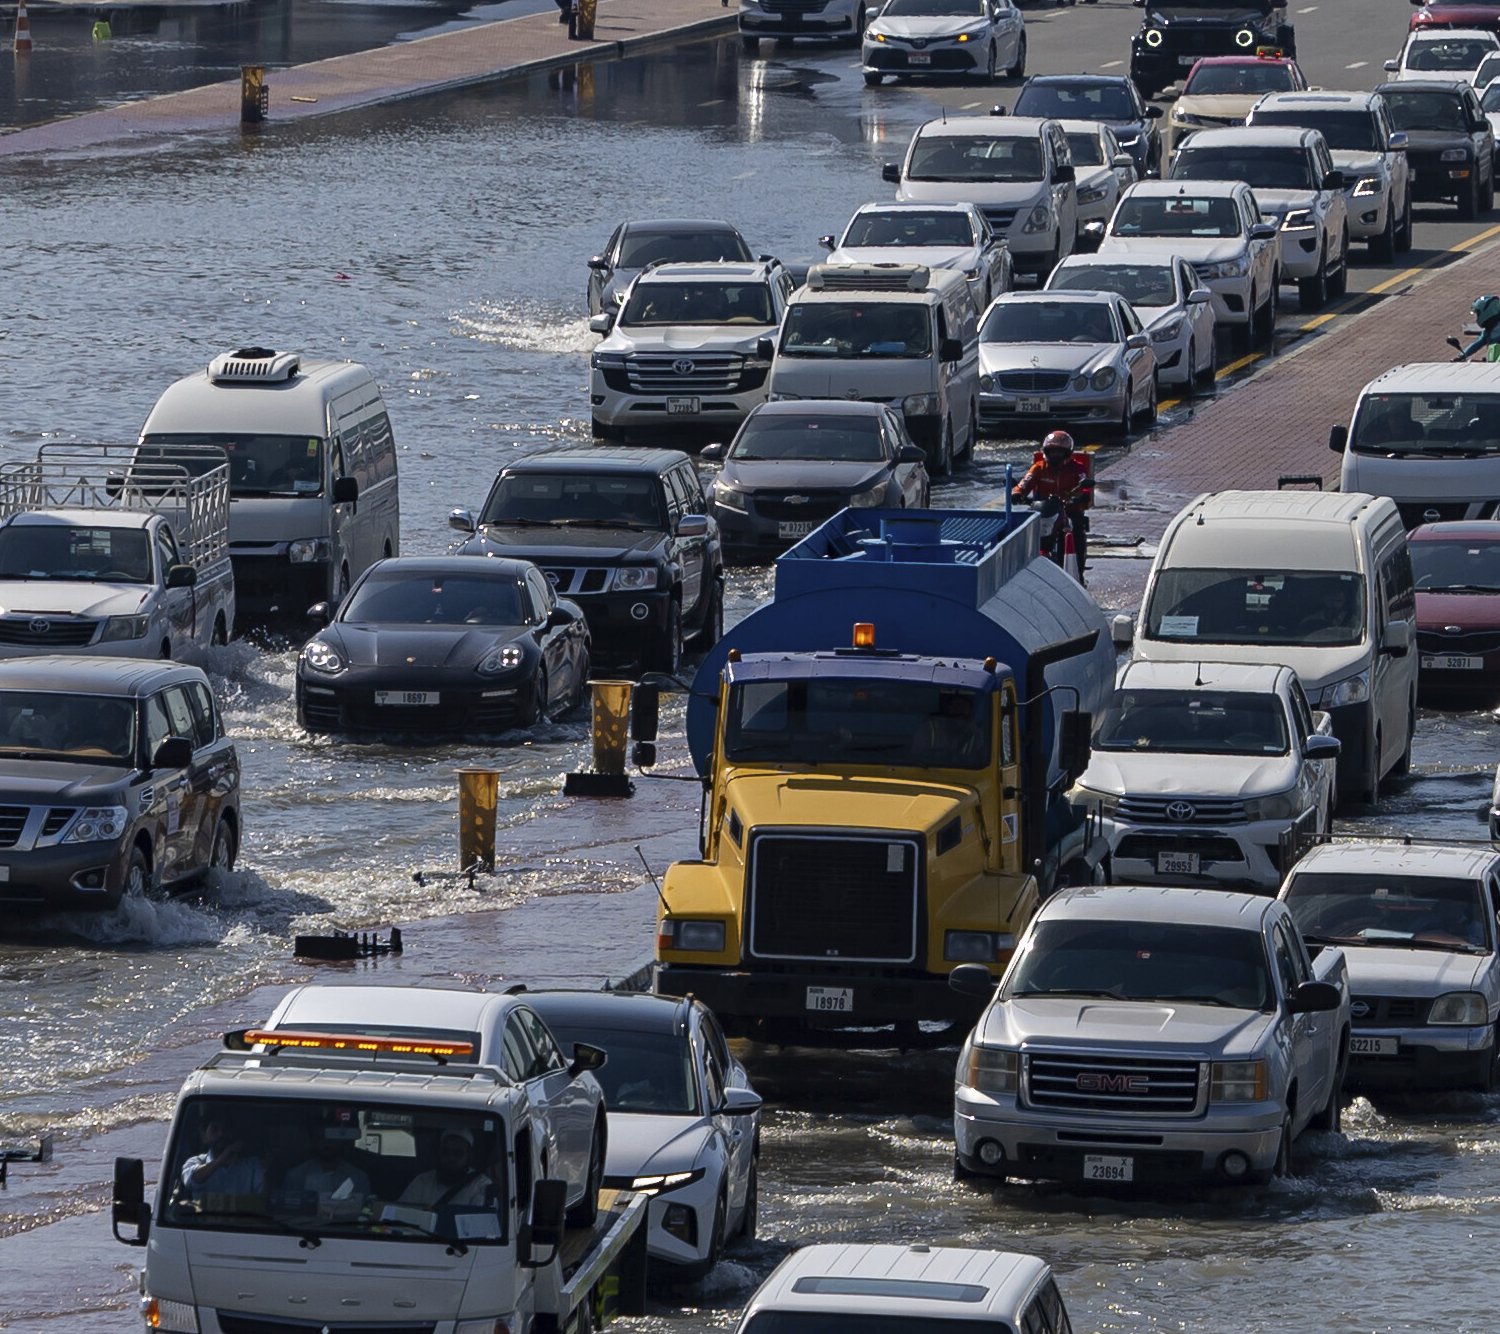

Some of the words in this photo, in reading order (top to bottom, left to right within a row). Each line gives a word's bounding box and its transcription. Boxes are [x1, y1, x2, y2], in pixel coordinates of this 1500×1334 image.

[815, 996, 845, 1010] 18978
[1350, 1040, 1381, 1052] 62215
[1077, 1073, 1149, 1092] GMC
[1092, 1165, 1125, 1179] 23694
